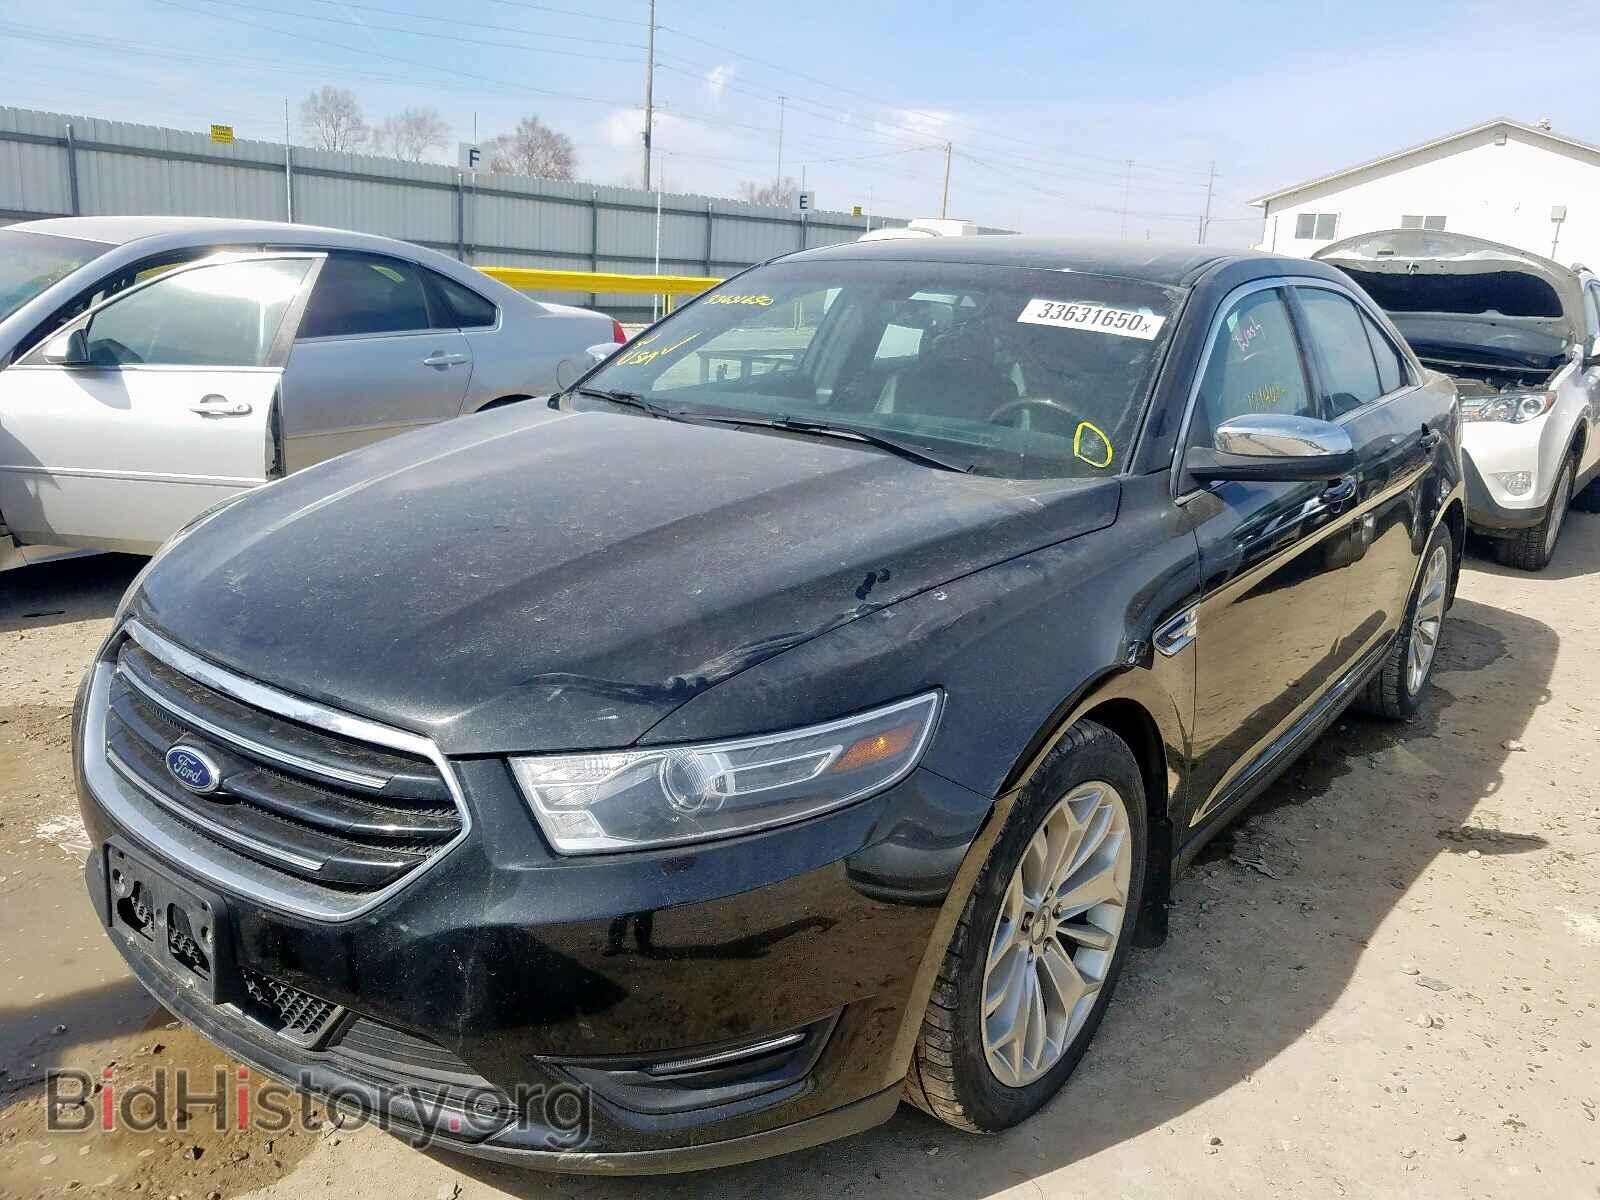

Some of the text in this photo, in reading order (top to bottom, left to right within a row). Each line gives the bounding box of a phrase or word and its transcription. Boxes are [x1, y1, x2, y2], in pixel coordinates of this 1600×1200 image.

[469, 149, 481, 167] F
[800, 195, 809, 210] E
[173, 754, 203, 784] Ford
